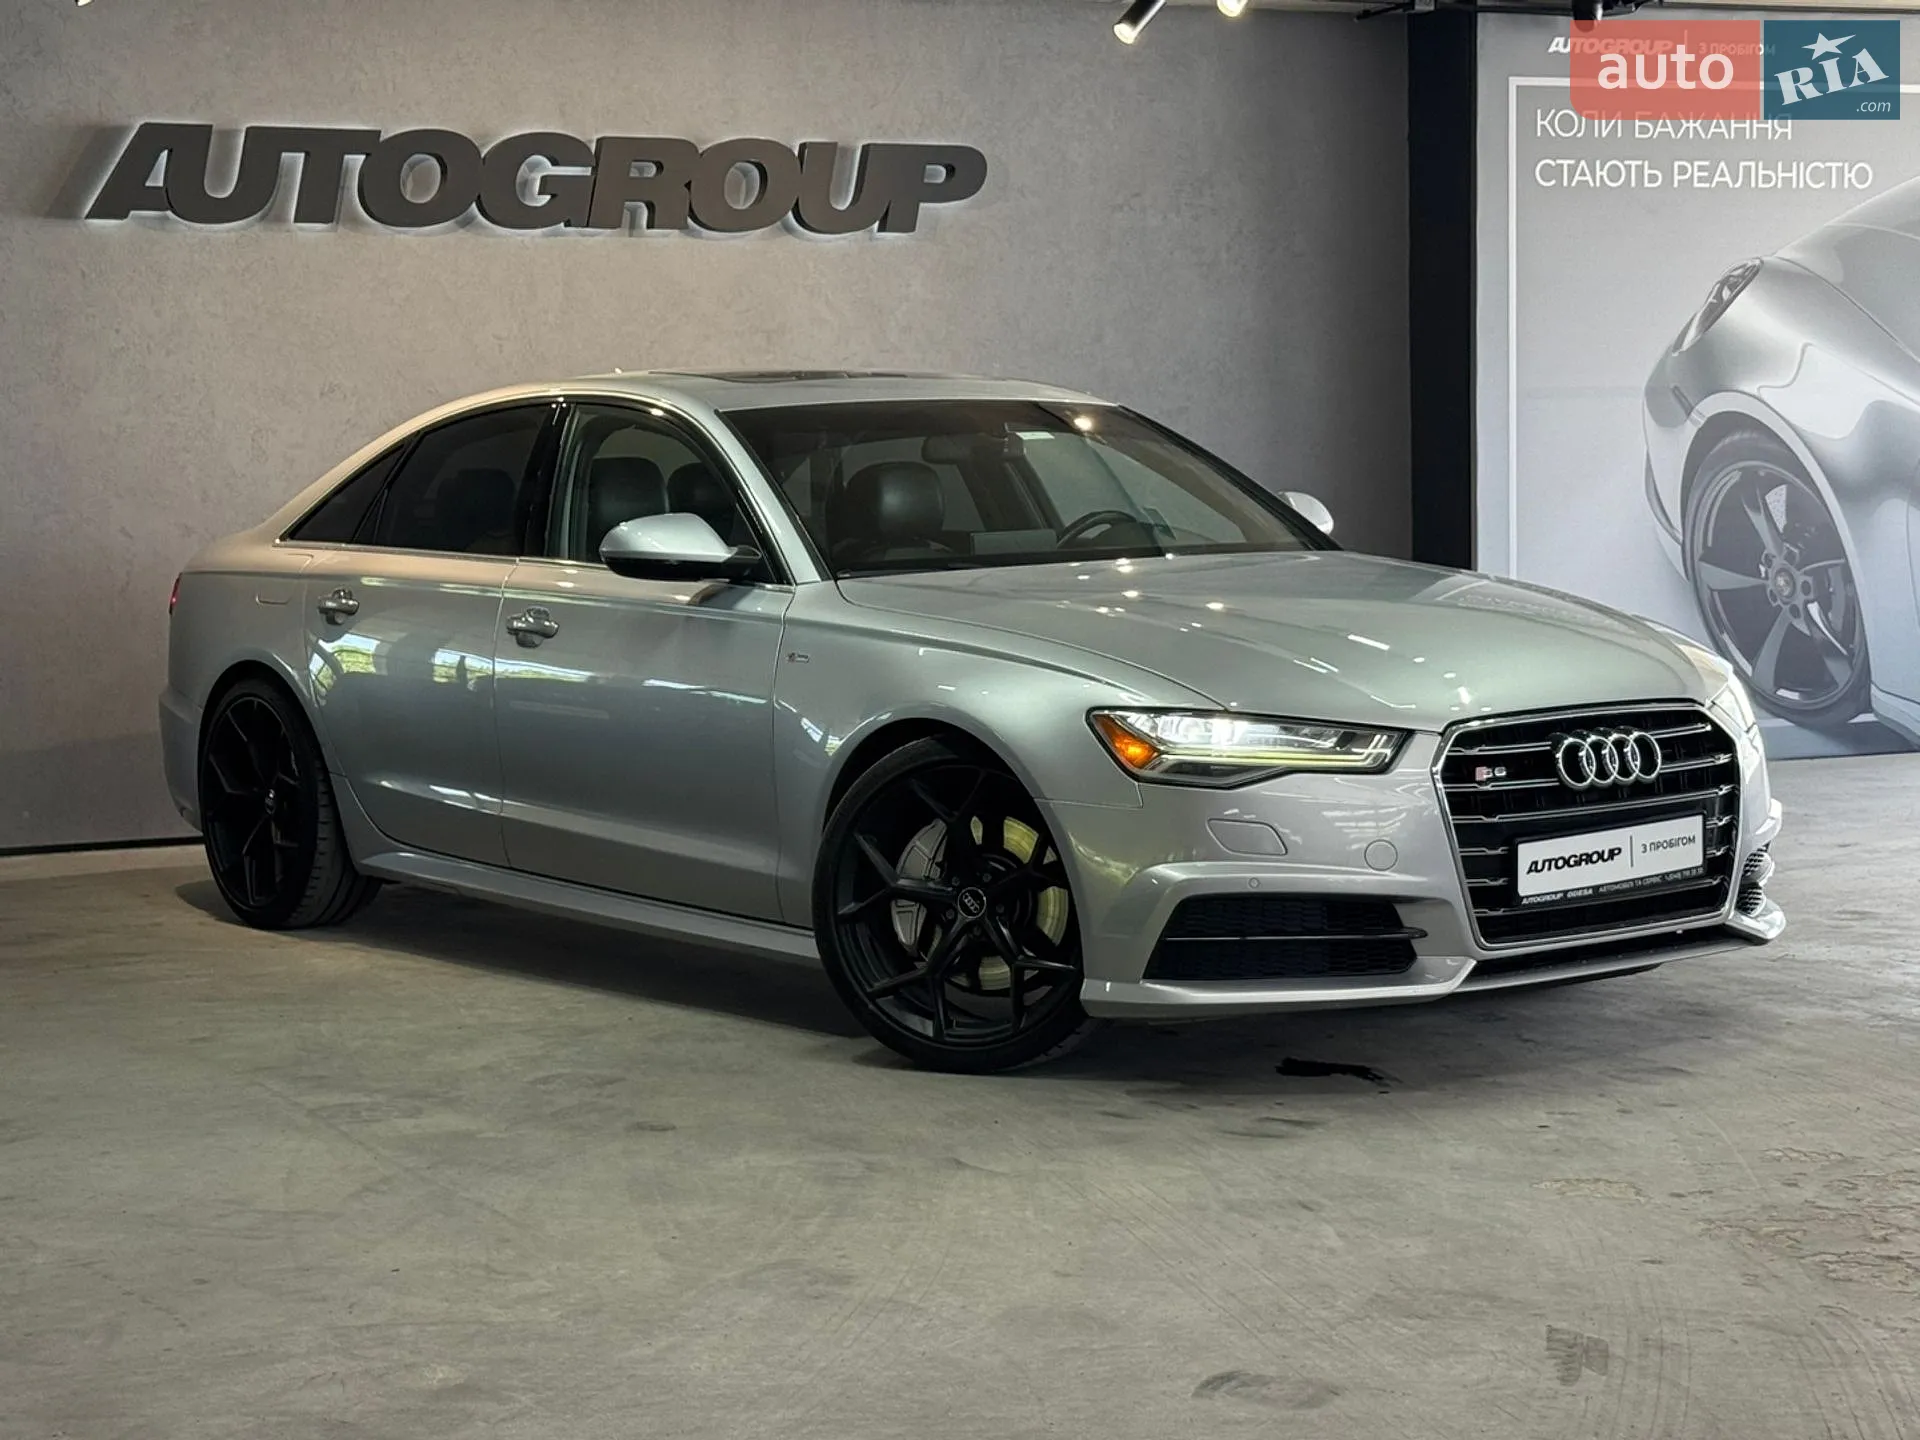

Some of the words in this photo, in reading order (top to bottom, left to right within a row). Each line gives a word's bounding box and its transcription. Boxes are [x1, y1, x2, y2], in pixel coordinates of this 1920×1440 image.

[1535, 109, 1622, 138] КОЛИ
[1634, 111, 1792, 140] БАЖАННЯ
[84, 122, 988, 234] AUTOGROUP
[1534, 158, 1662, 188] СТАЮТЬ
[1673, 160, 1873, 190] РЕАЛЬНІСТЮ
[1649, 834, 1696, 852] ПРОБІГОМ
[1527, 847, 1623, 875] AUTOGROUP
